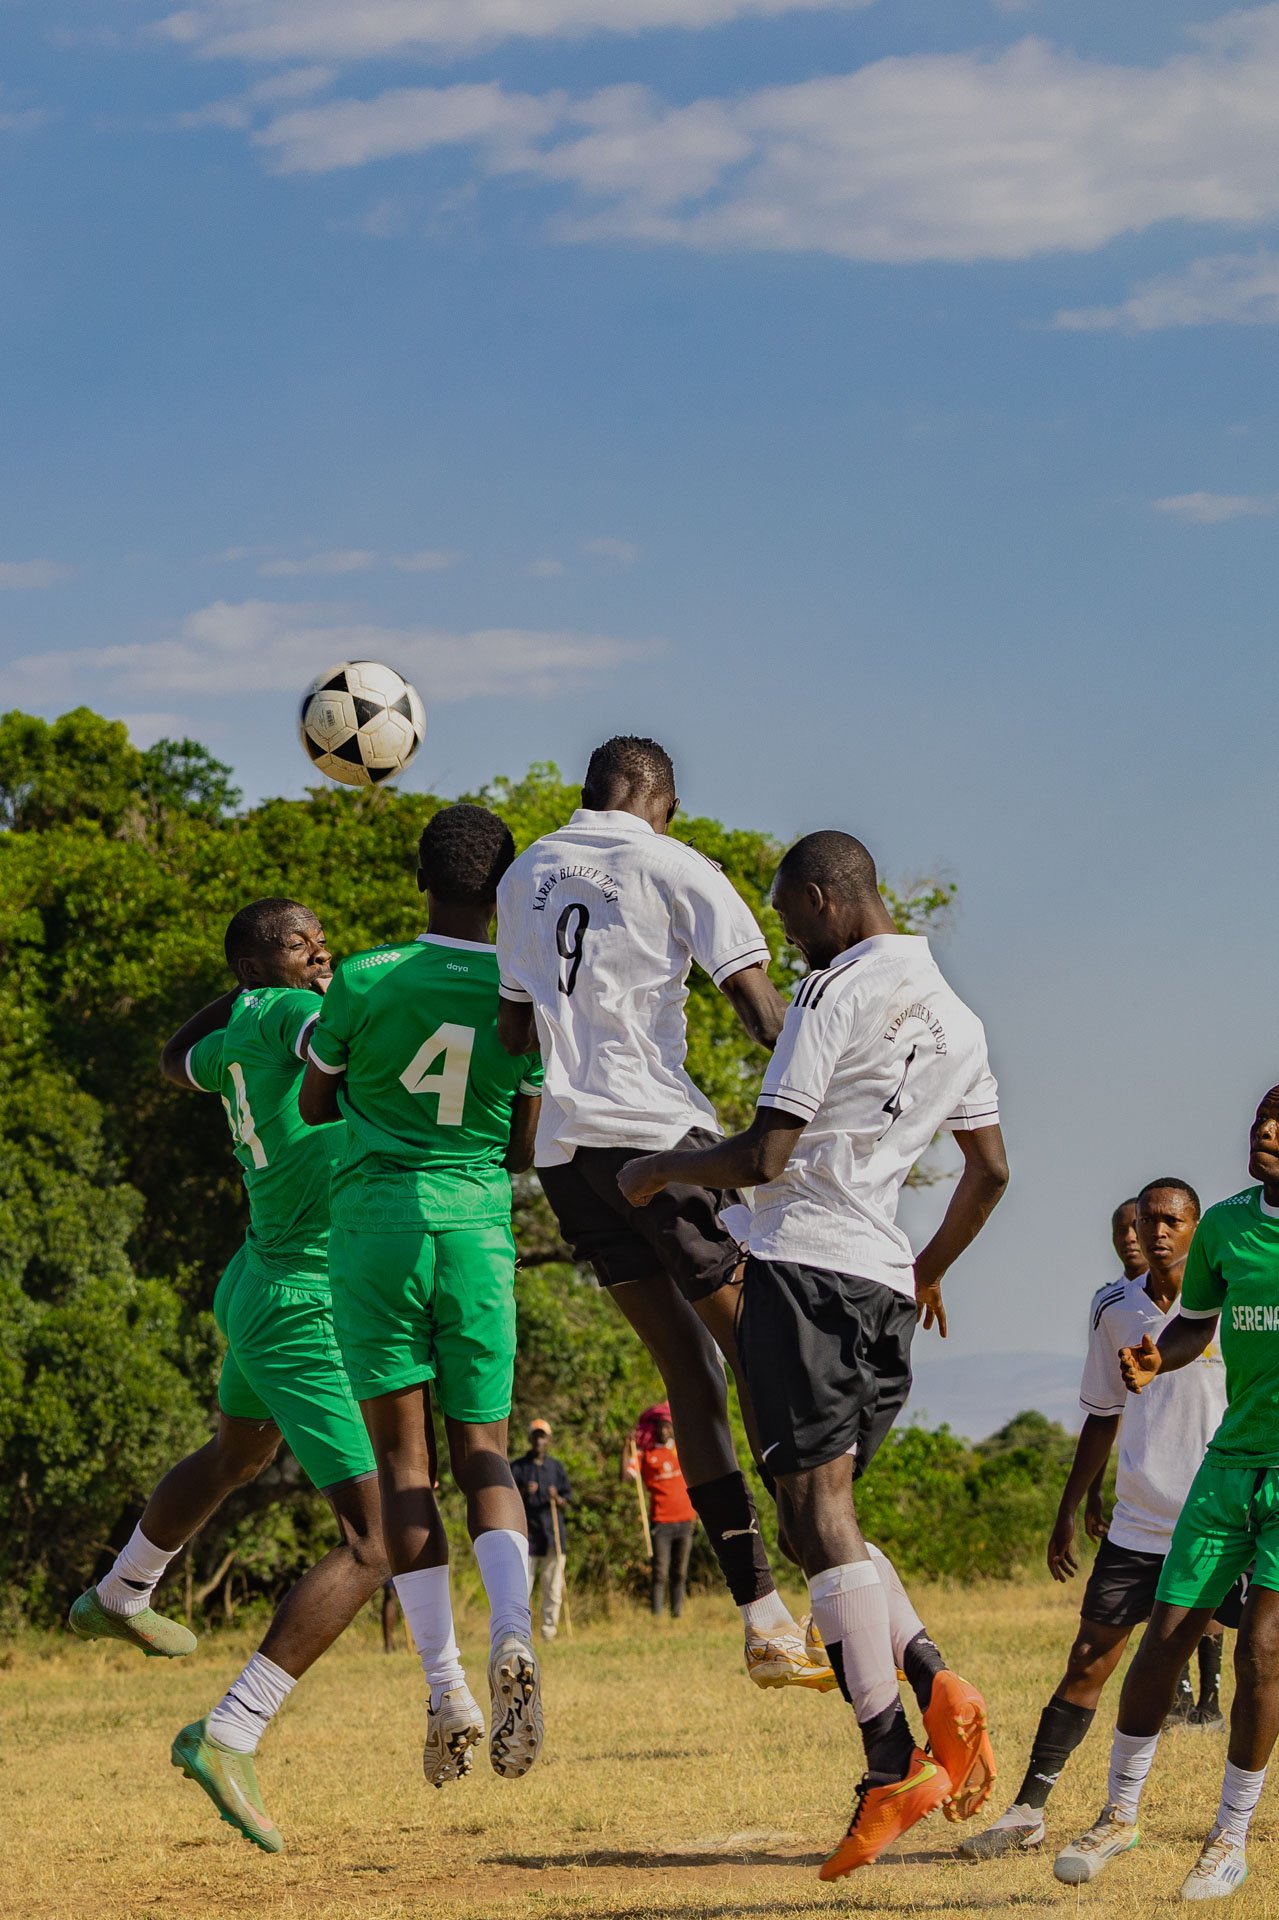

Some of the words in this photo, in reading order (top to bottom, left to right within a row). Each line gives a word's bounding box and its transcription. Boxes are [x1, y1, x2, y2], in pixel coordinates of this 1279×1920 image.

[533, 874, 558, 911] KAREN
[559, 865, 602, 881] BLIXEN
[596, 874, 619, 904] TRUST
[446, 961, 469, 973] daya
[556, 902, 590, 997] 9
[929, 1018, 948, 1057] TRUST
[398, 1021, 476, 1127] 4
